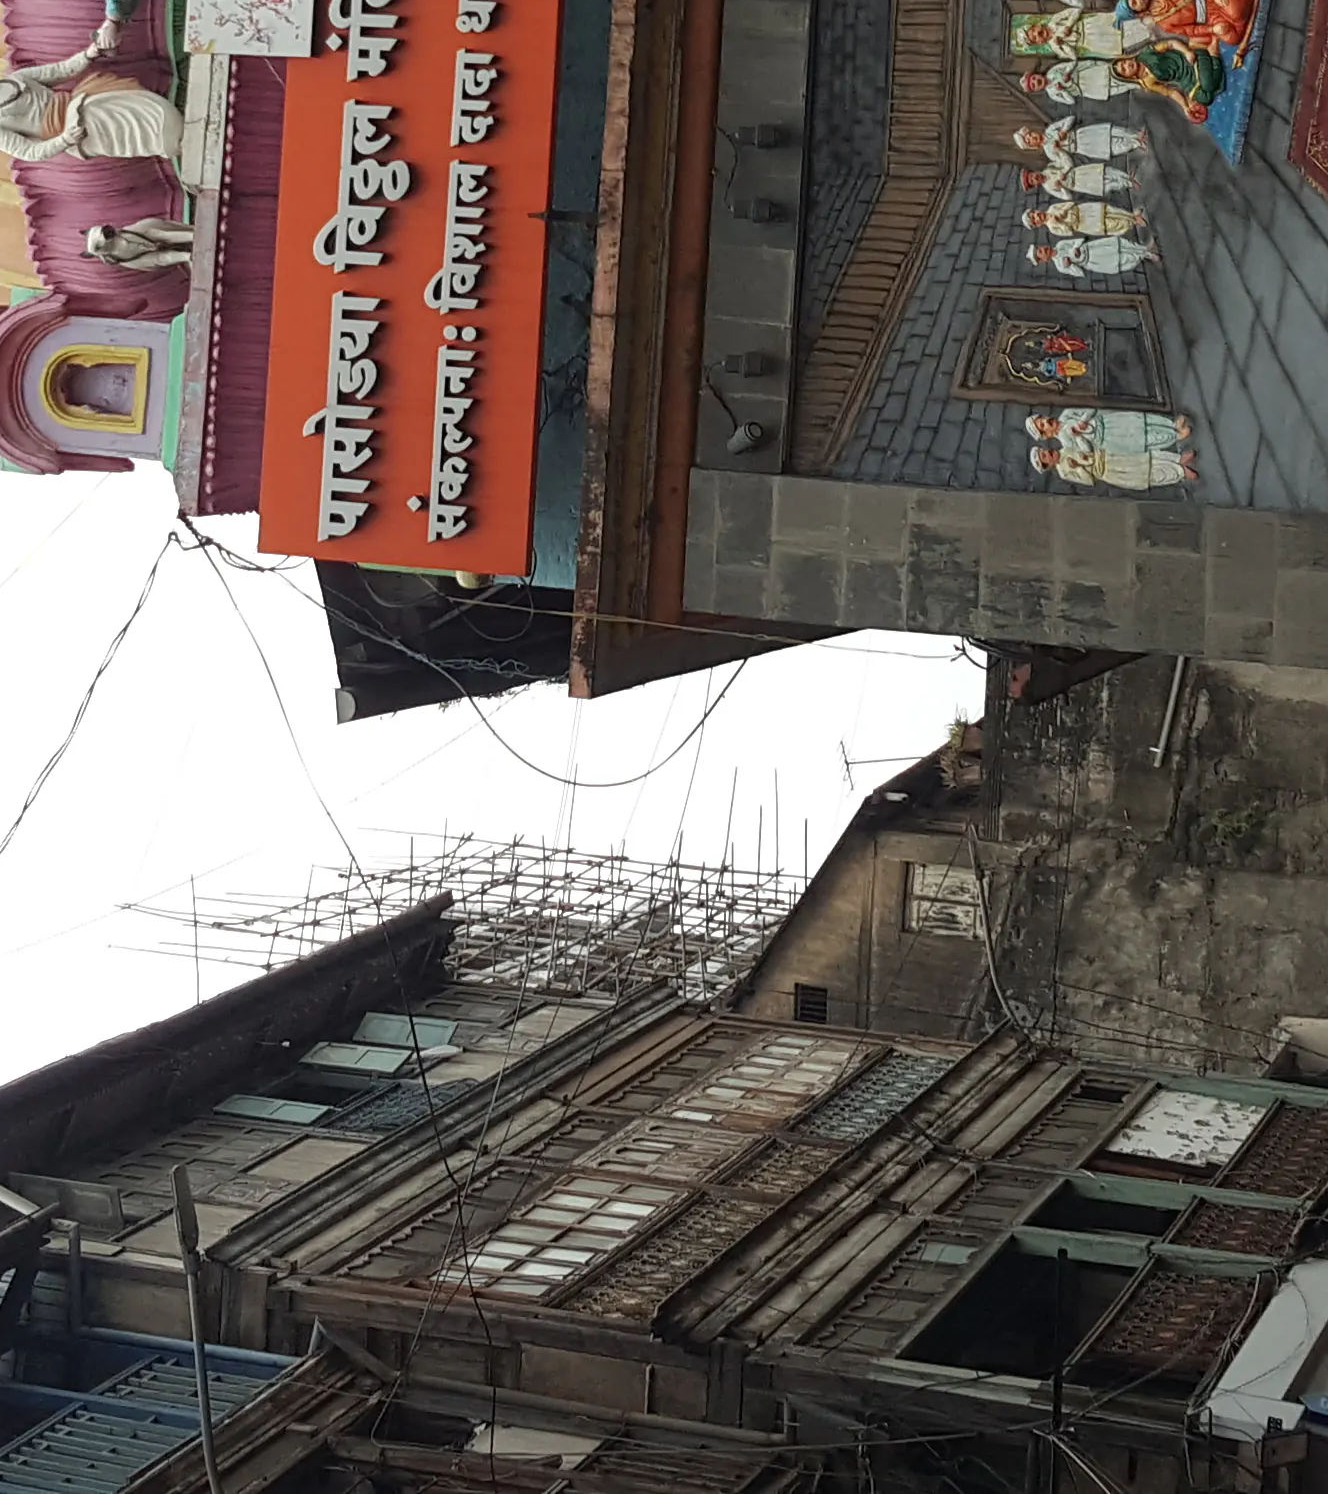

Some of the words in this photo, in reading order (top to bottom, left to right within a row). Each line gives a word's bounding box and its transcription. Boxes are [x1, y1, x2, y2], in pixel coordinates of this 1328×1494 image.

[449, 50, 499, 146] दादा
[313, 100, 411, 271] विठ्ठल
[424, 159, 490, 312] विशाल
